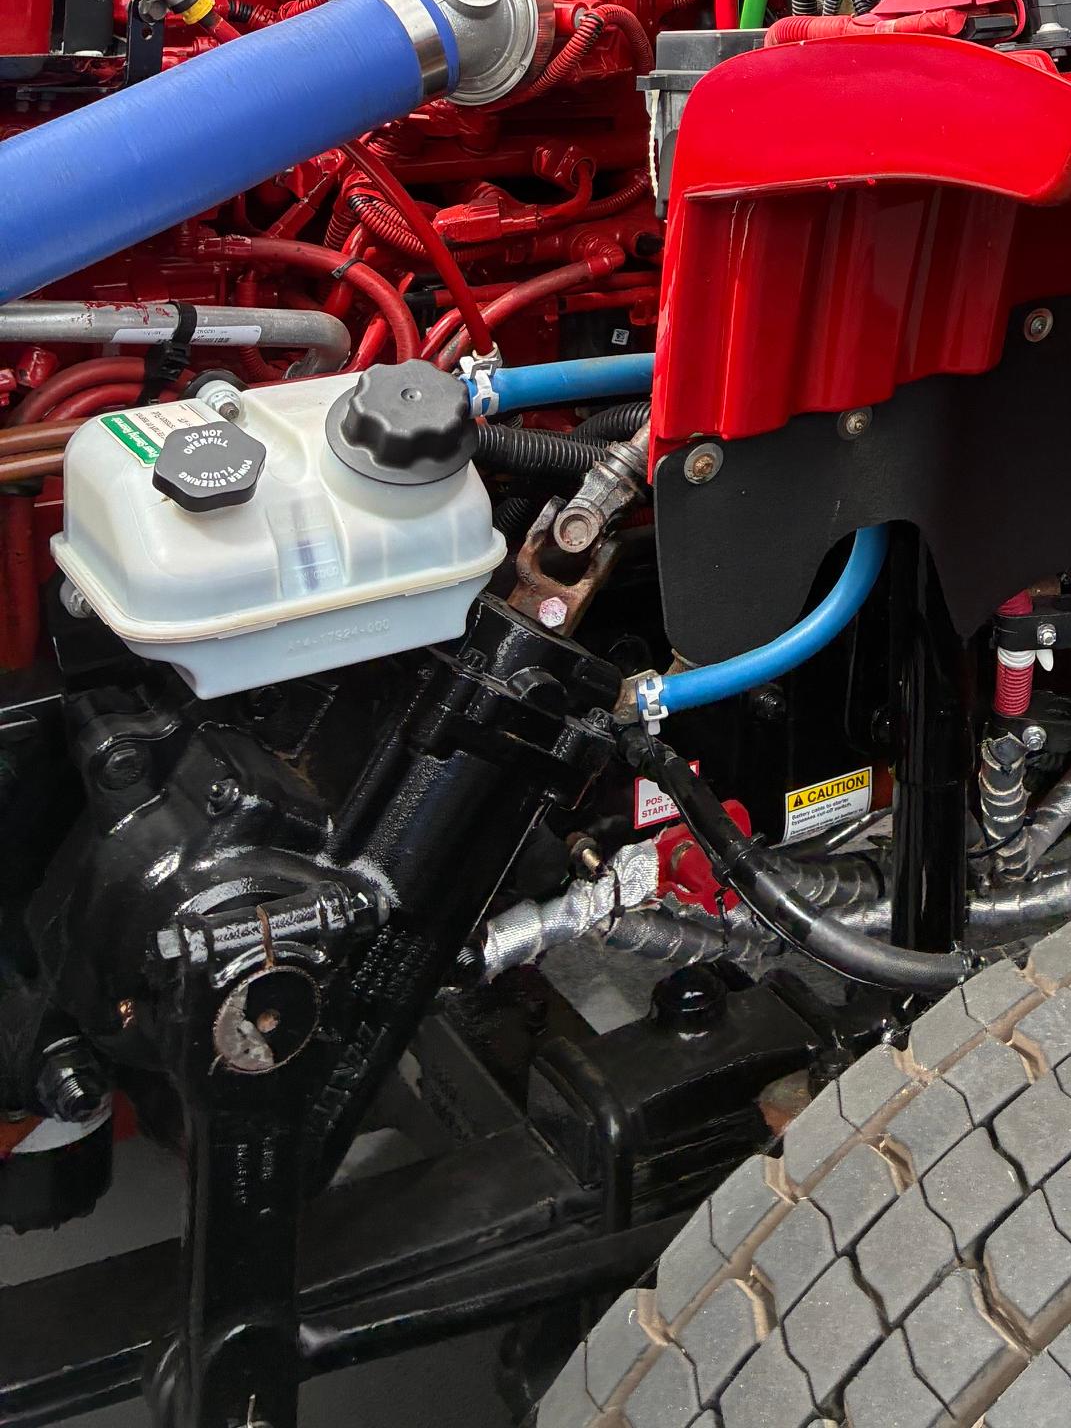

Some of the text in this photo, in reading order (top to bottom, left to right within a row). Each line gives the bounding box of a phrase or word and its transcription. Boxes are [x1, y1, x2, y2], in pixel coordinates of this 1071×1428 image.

[184, 429, 223, 441] DO NOT
[183, 437, 229, 455] OVERFILL
[178, 459, 253, 488] POWER STEERING
[200, 466, 234, 480] FLUID
[807, 774, 864, 803] CAUTION
[645, 795, 663, 807] POS
[641, 803, 668, 818] START
